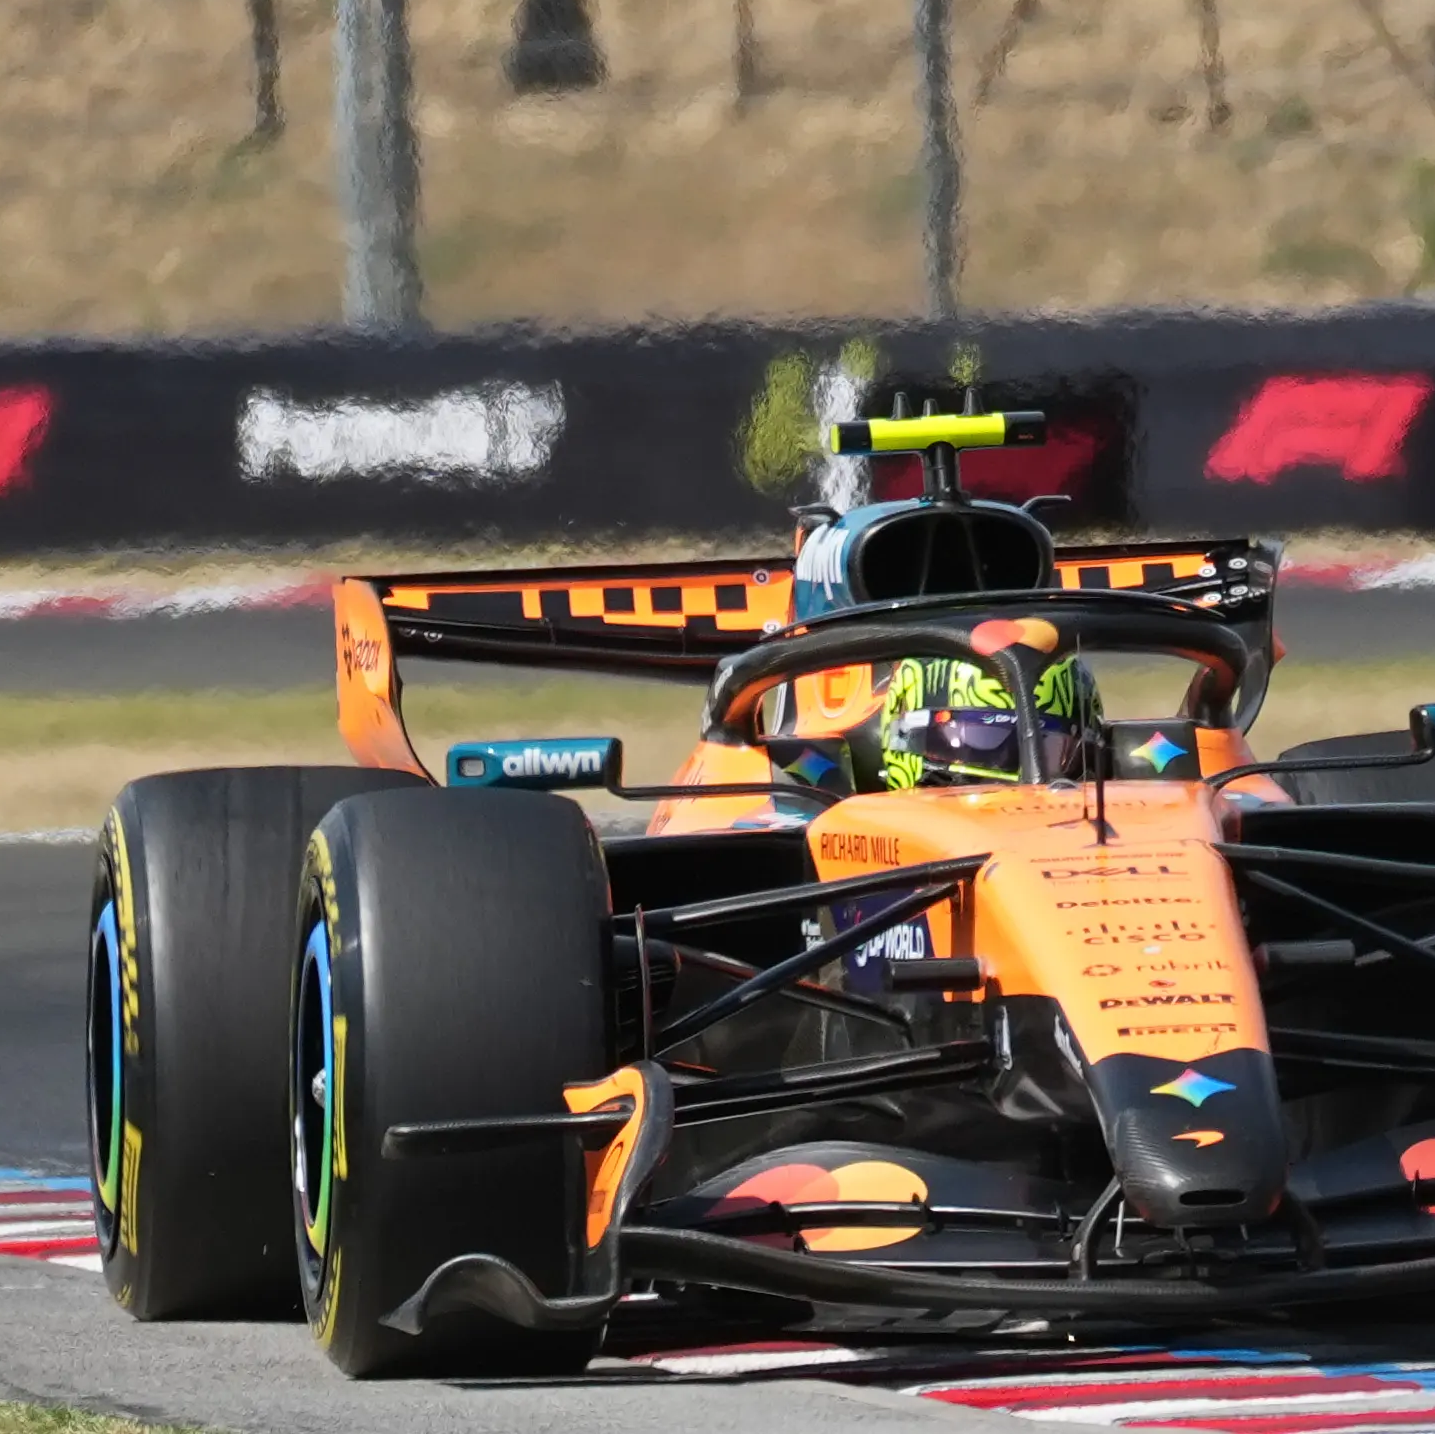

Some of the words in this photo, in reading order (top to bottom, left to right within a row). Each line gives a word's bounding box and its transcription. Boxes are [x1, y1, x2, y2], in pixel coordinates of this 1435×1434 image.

[502, 748, 601, 780] allwyn
[820, 833, 868, 863] RICHARD
[870, 836, 901, 866] MILLE
[1041, 865, 1190, 880] DELL
[884, 923, 925, 960] WORLD
[1135, 959, 1235, 973] rubrik
